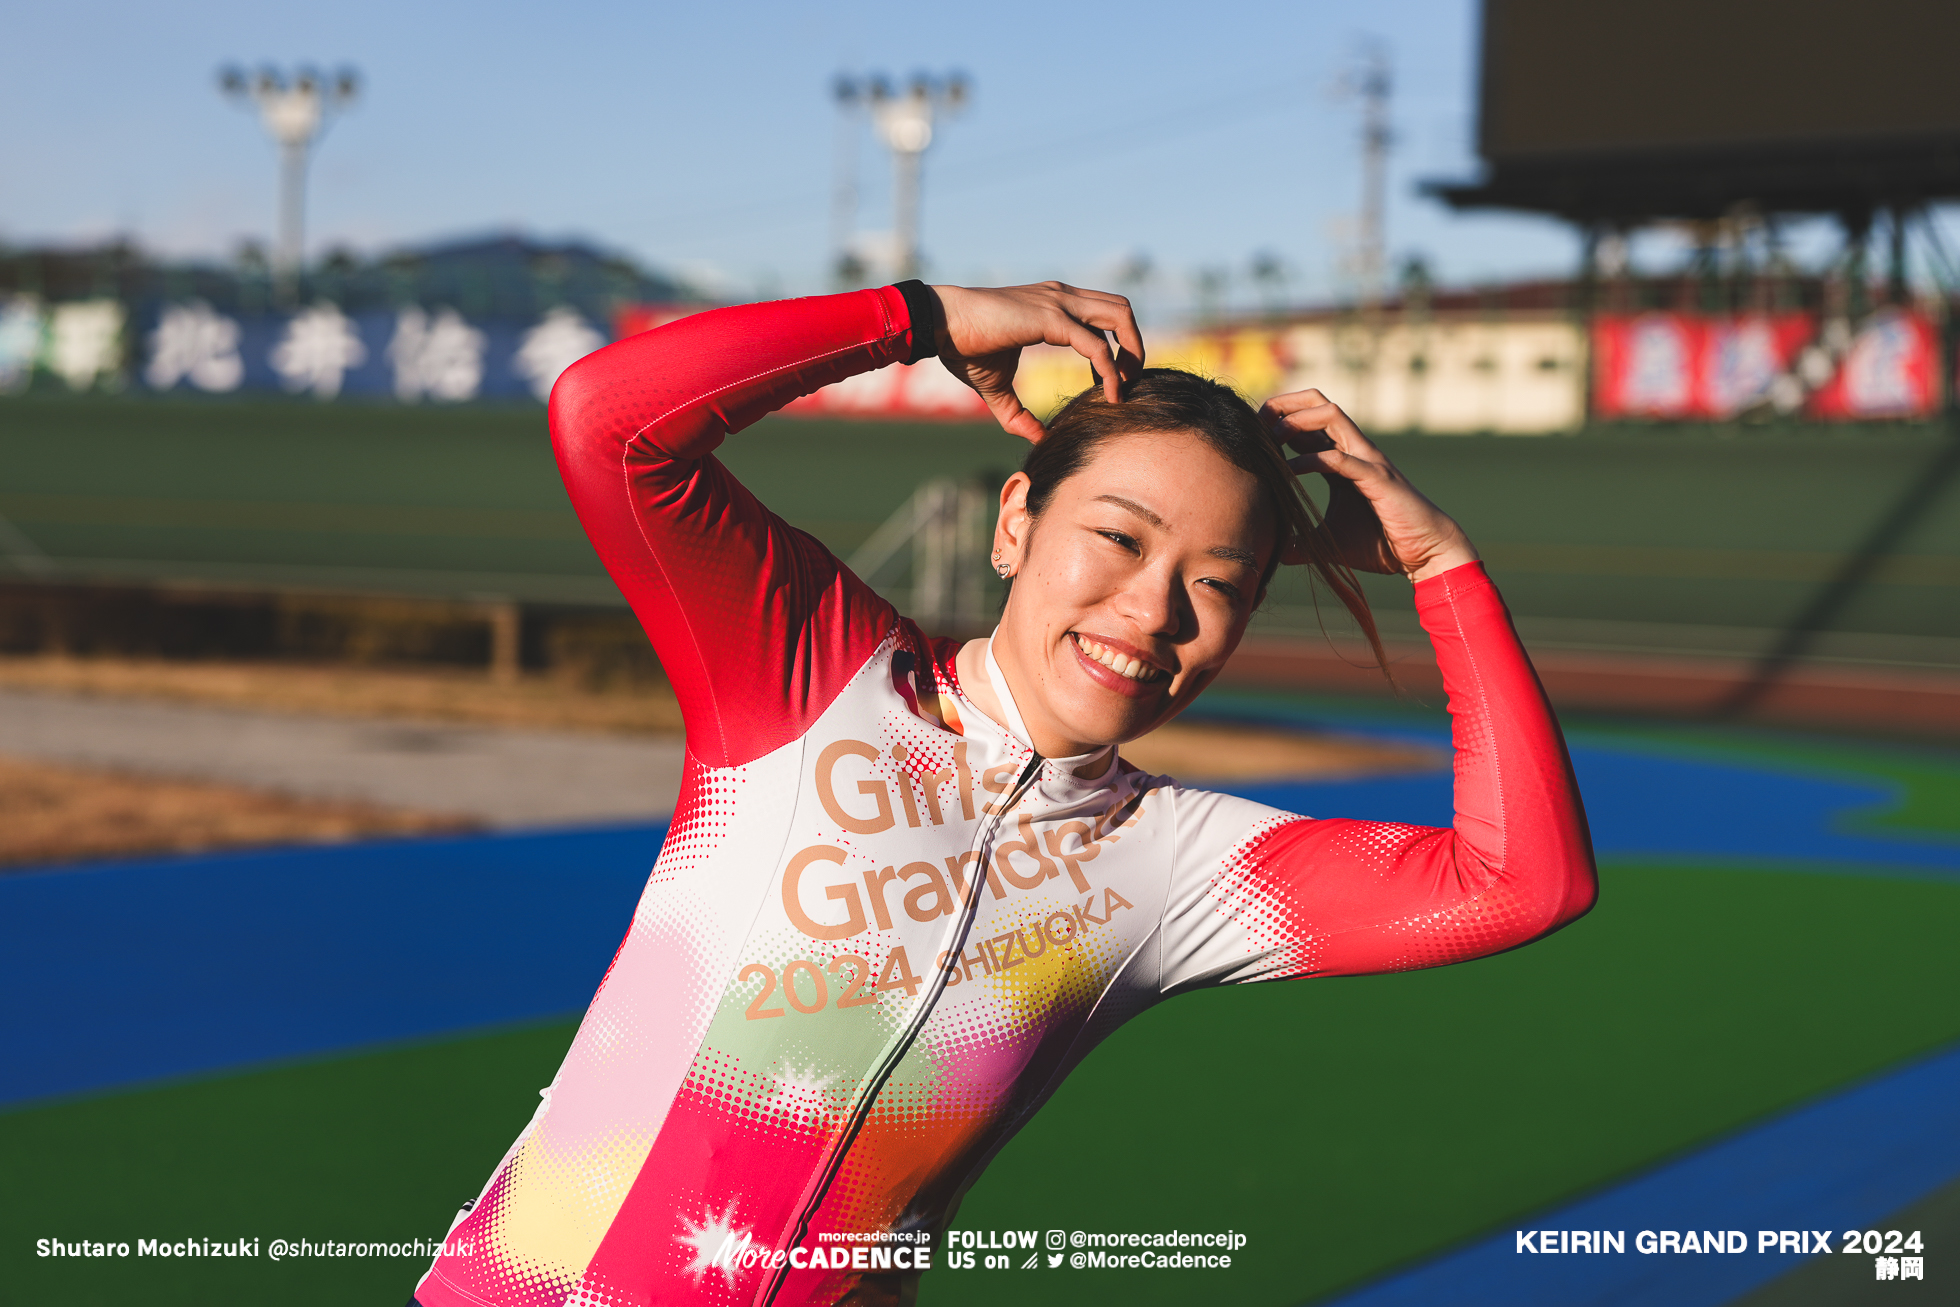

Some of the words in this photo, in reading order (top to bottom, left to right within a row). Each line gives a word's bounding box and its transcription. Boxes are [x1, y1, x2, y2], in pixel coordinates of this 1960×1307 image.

[814, 739, 1021, 835] Girls
[738, 945, 923, 1021] 2024
[935, 886, 1134, 988] SHIZUOKA
